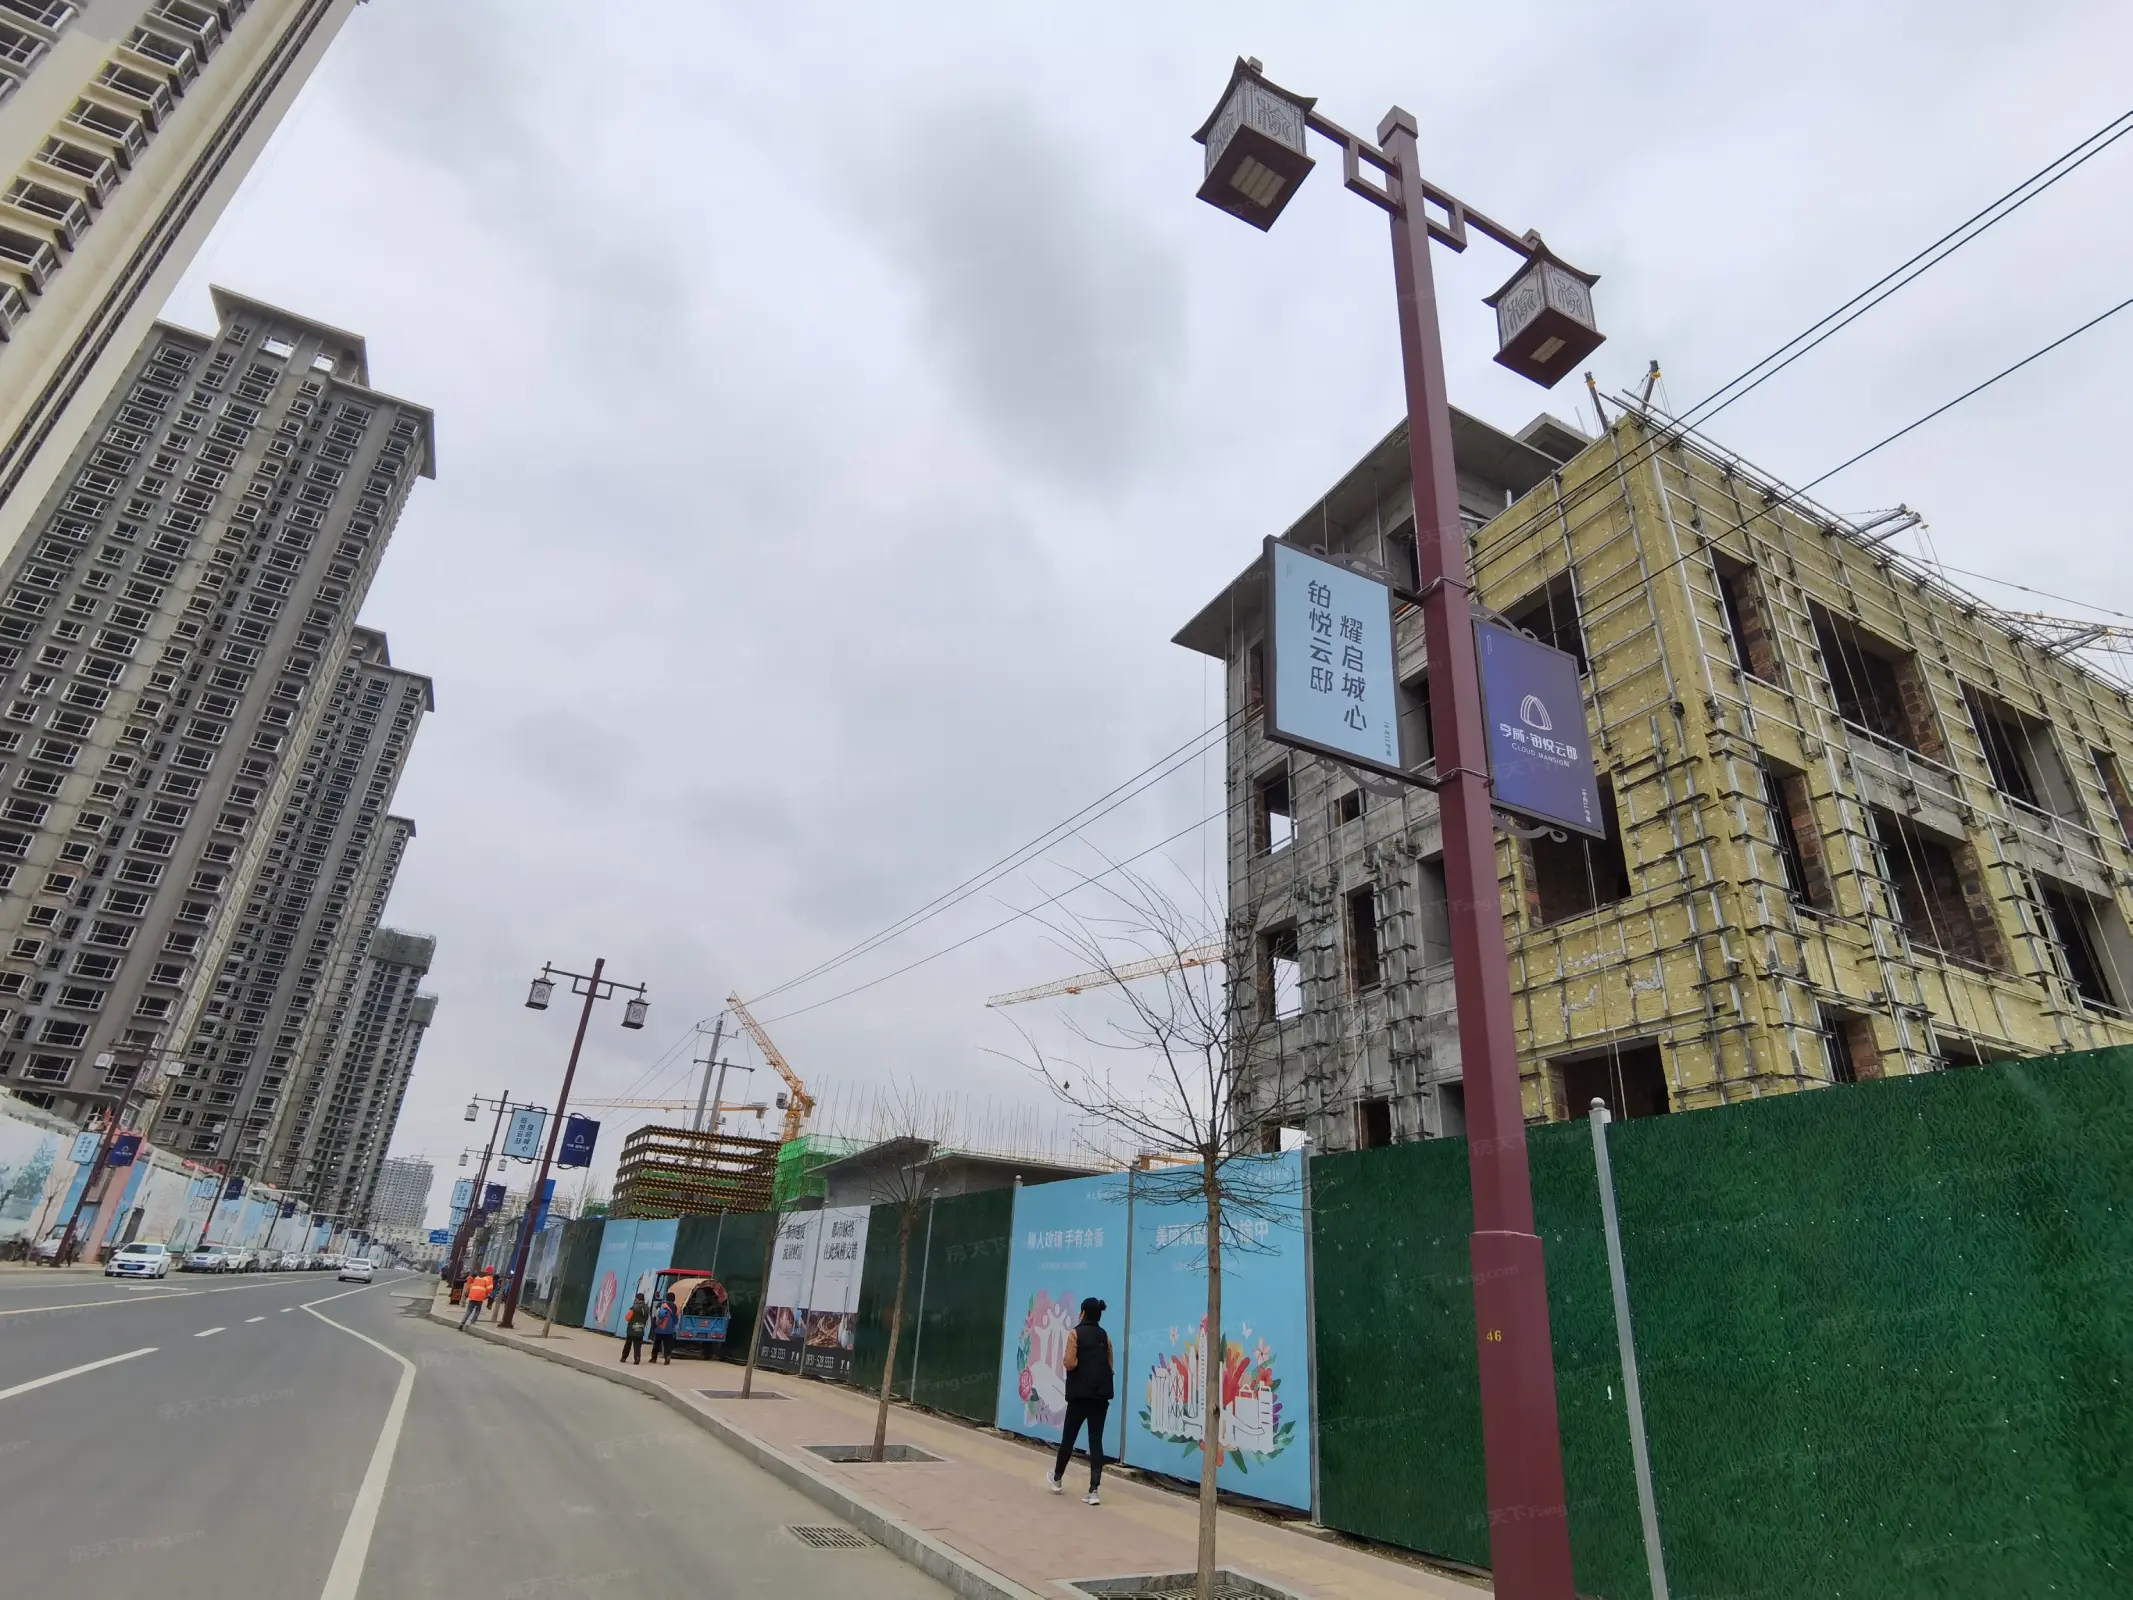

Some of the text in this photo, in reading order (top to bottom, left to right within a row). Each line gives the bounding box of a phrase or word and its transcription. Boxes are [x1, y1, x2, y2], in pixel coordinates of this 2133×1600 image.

[1308, 579, 1334, 695] 铂悦云邸
[1340, 615, 1367, 731] 耀启城心
[1511, 742, 1536, 756] CLOUD
[1538, 752, 1570, 769] MANSION
[1065, 1228, 1104, 1250] 手有余香
[1218, 1218, 1269, 1245] 力榆中
[1486, 1328, 1502, 1343] 46
